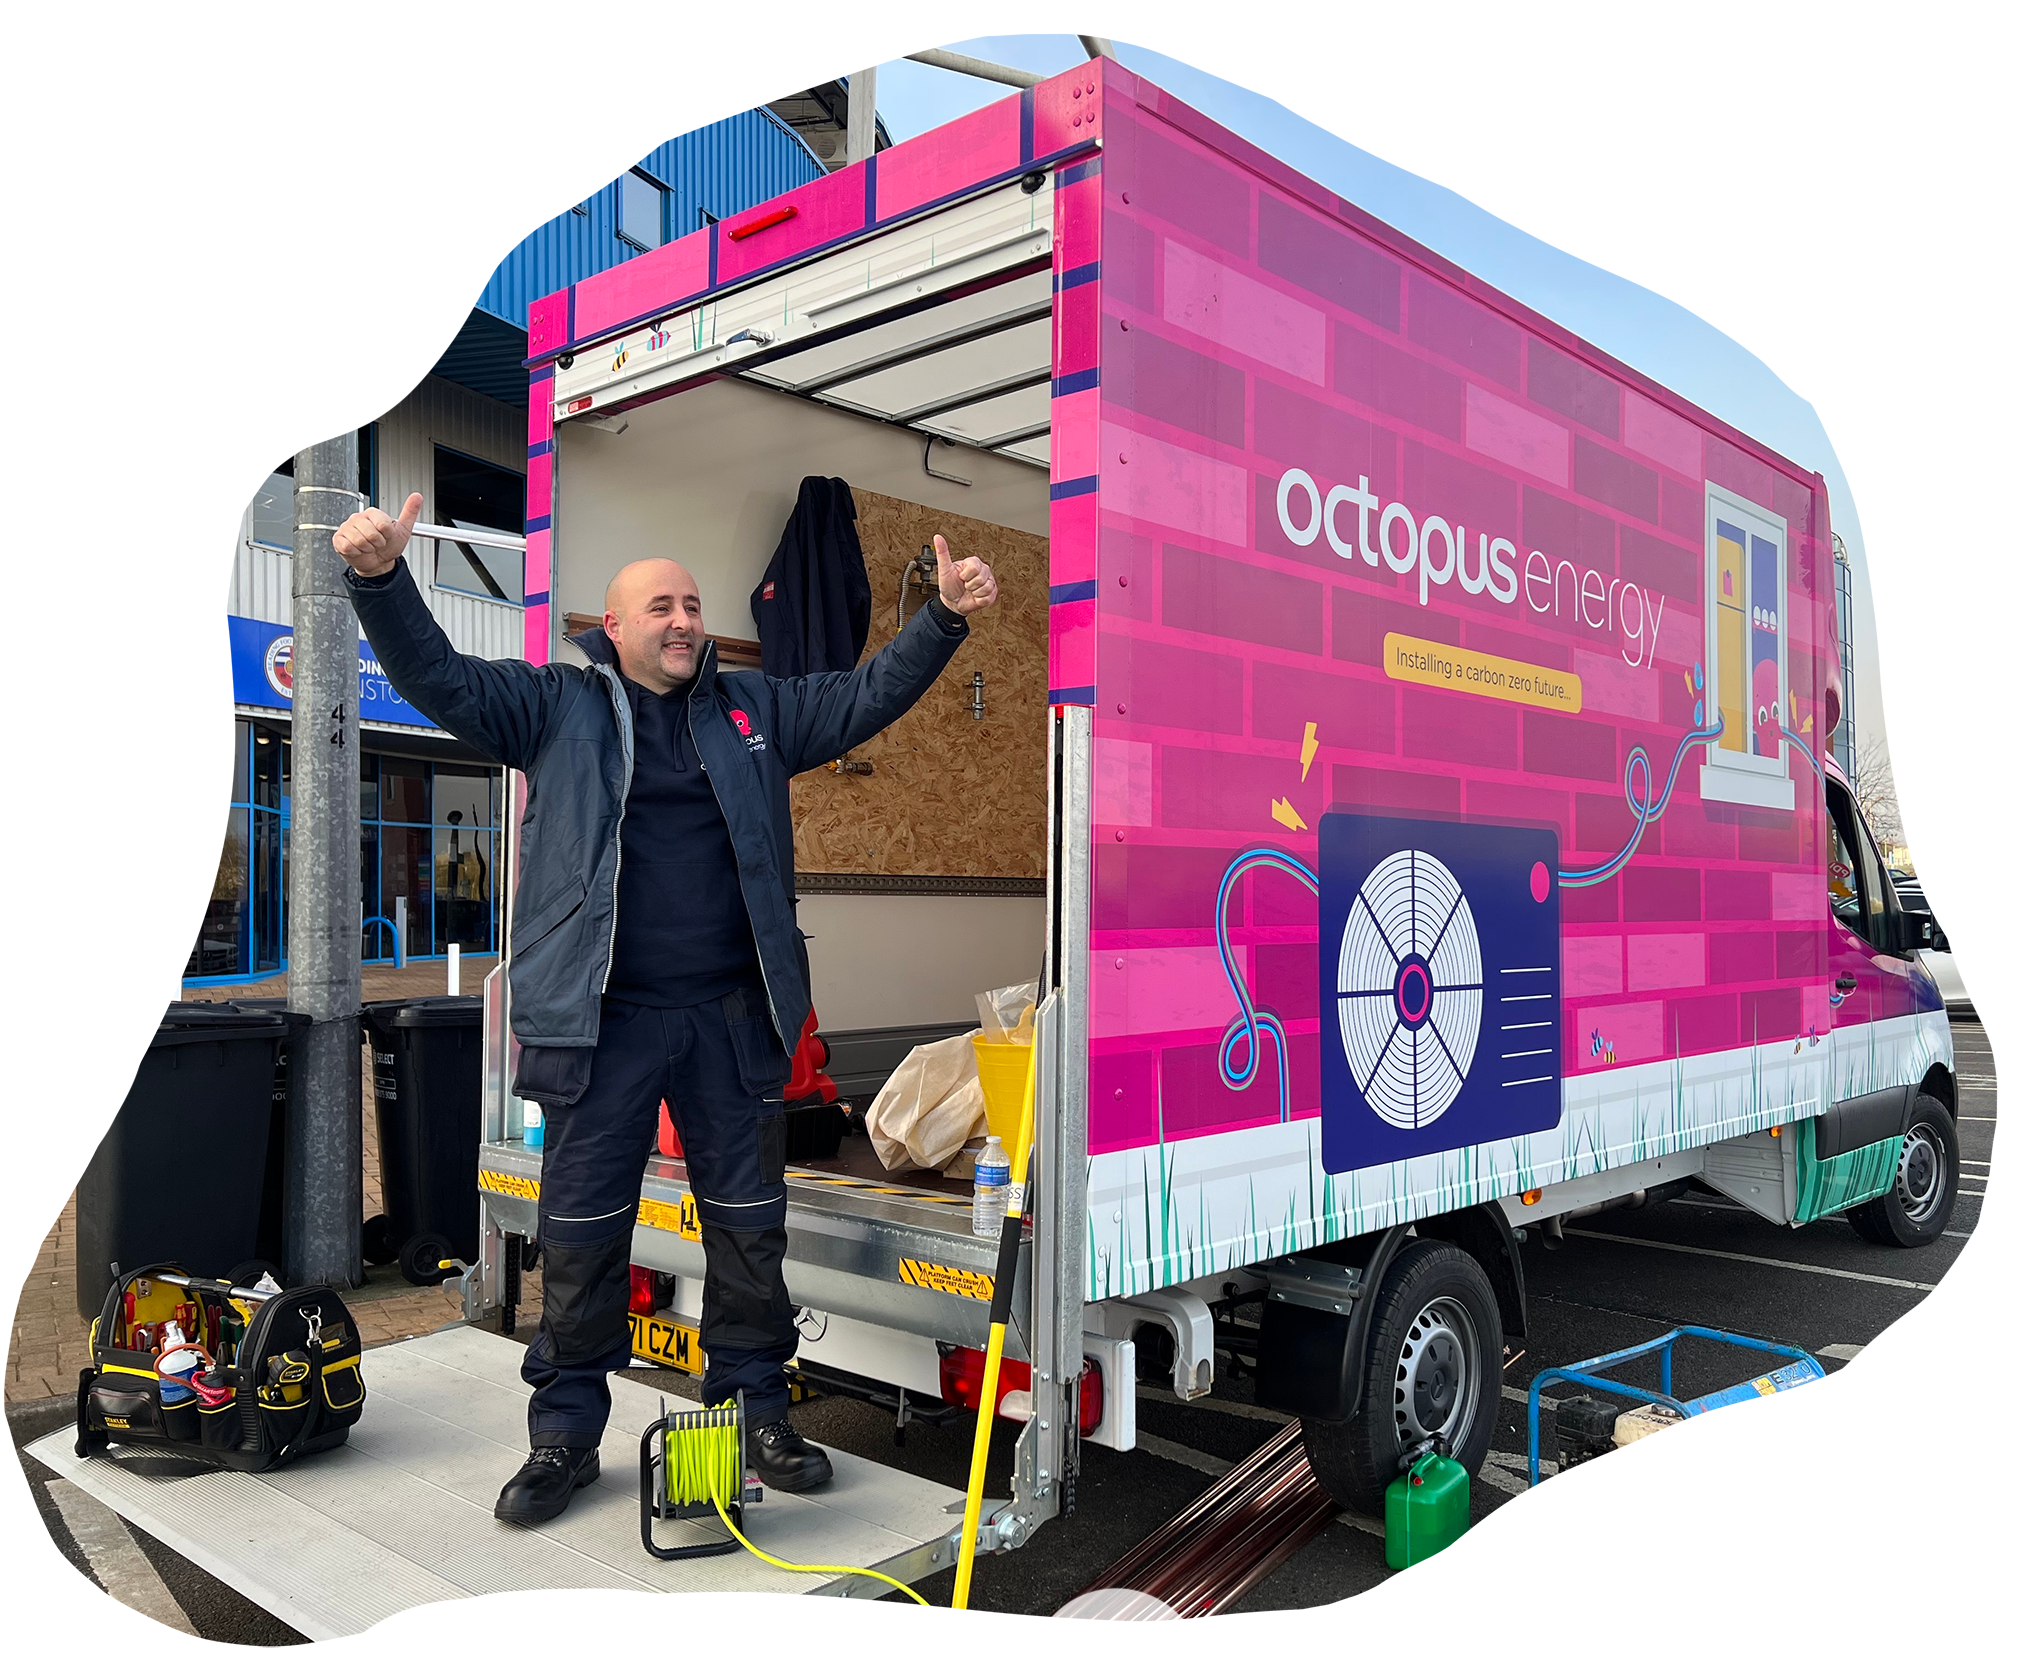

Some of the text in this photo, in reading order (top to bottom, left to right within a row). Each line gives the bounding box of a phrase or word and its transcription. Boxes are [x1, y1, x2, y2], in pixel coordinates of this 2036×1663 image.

[1276, 468, 1665, 670] octopus energy
[1396, 647, 1452, 679] Installing
[1455, 664, 1463, 678] a
[1466, 665, 1505, 687] carbon
[1508, 675, 1532, 692] zero
[928, 1271, 951, 1280] PLATFORM
[963, 1278, 979, 1286] CRUSH
[957, 1282, 973, 1290] CLEAR
[649, 1321, 689, 1365] CZM
